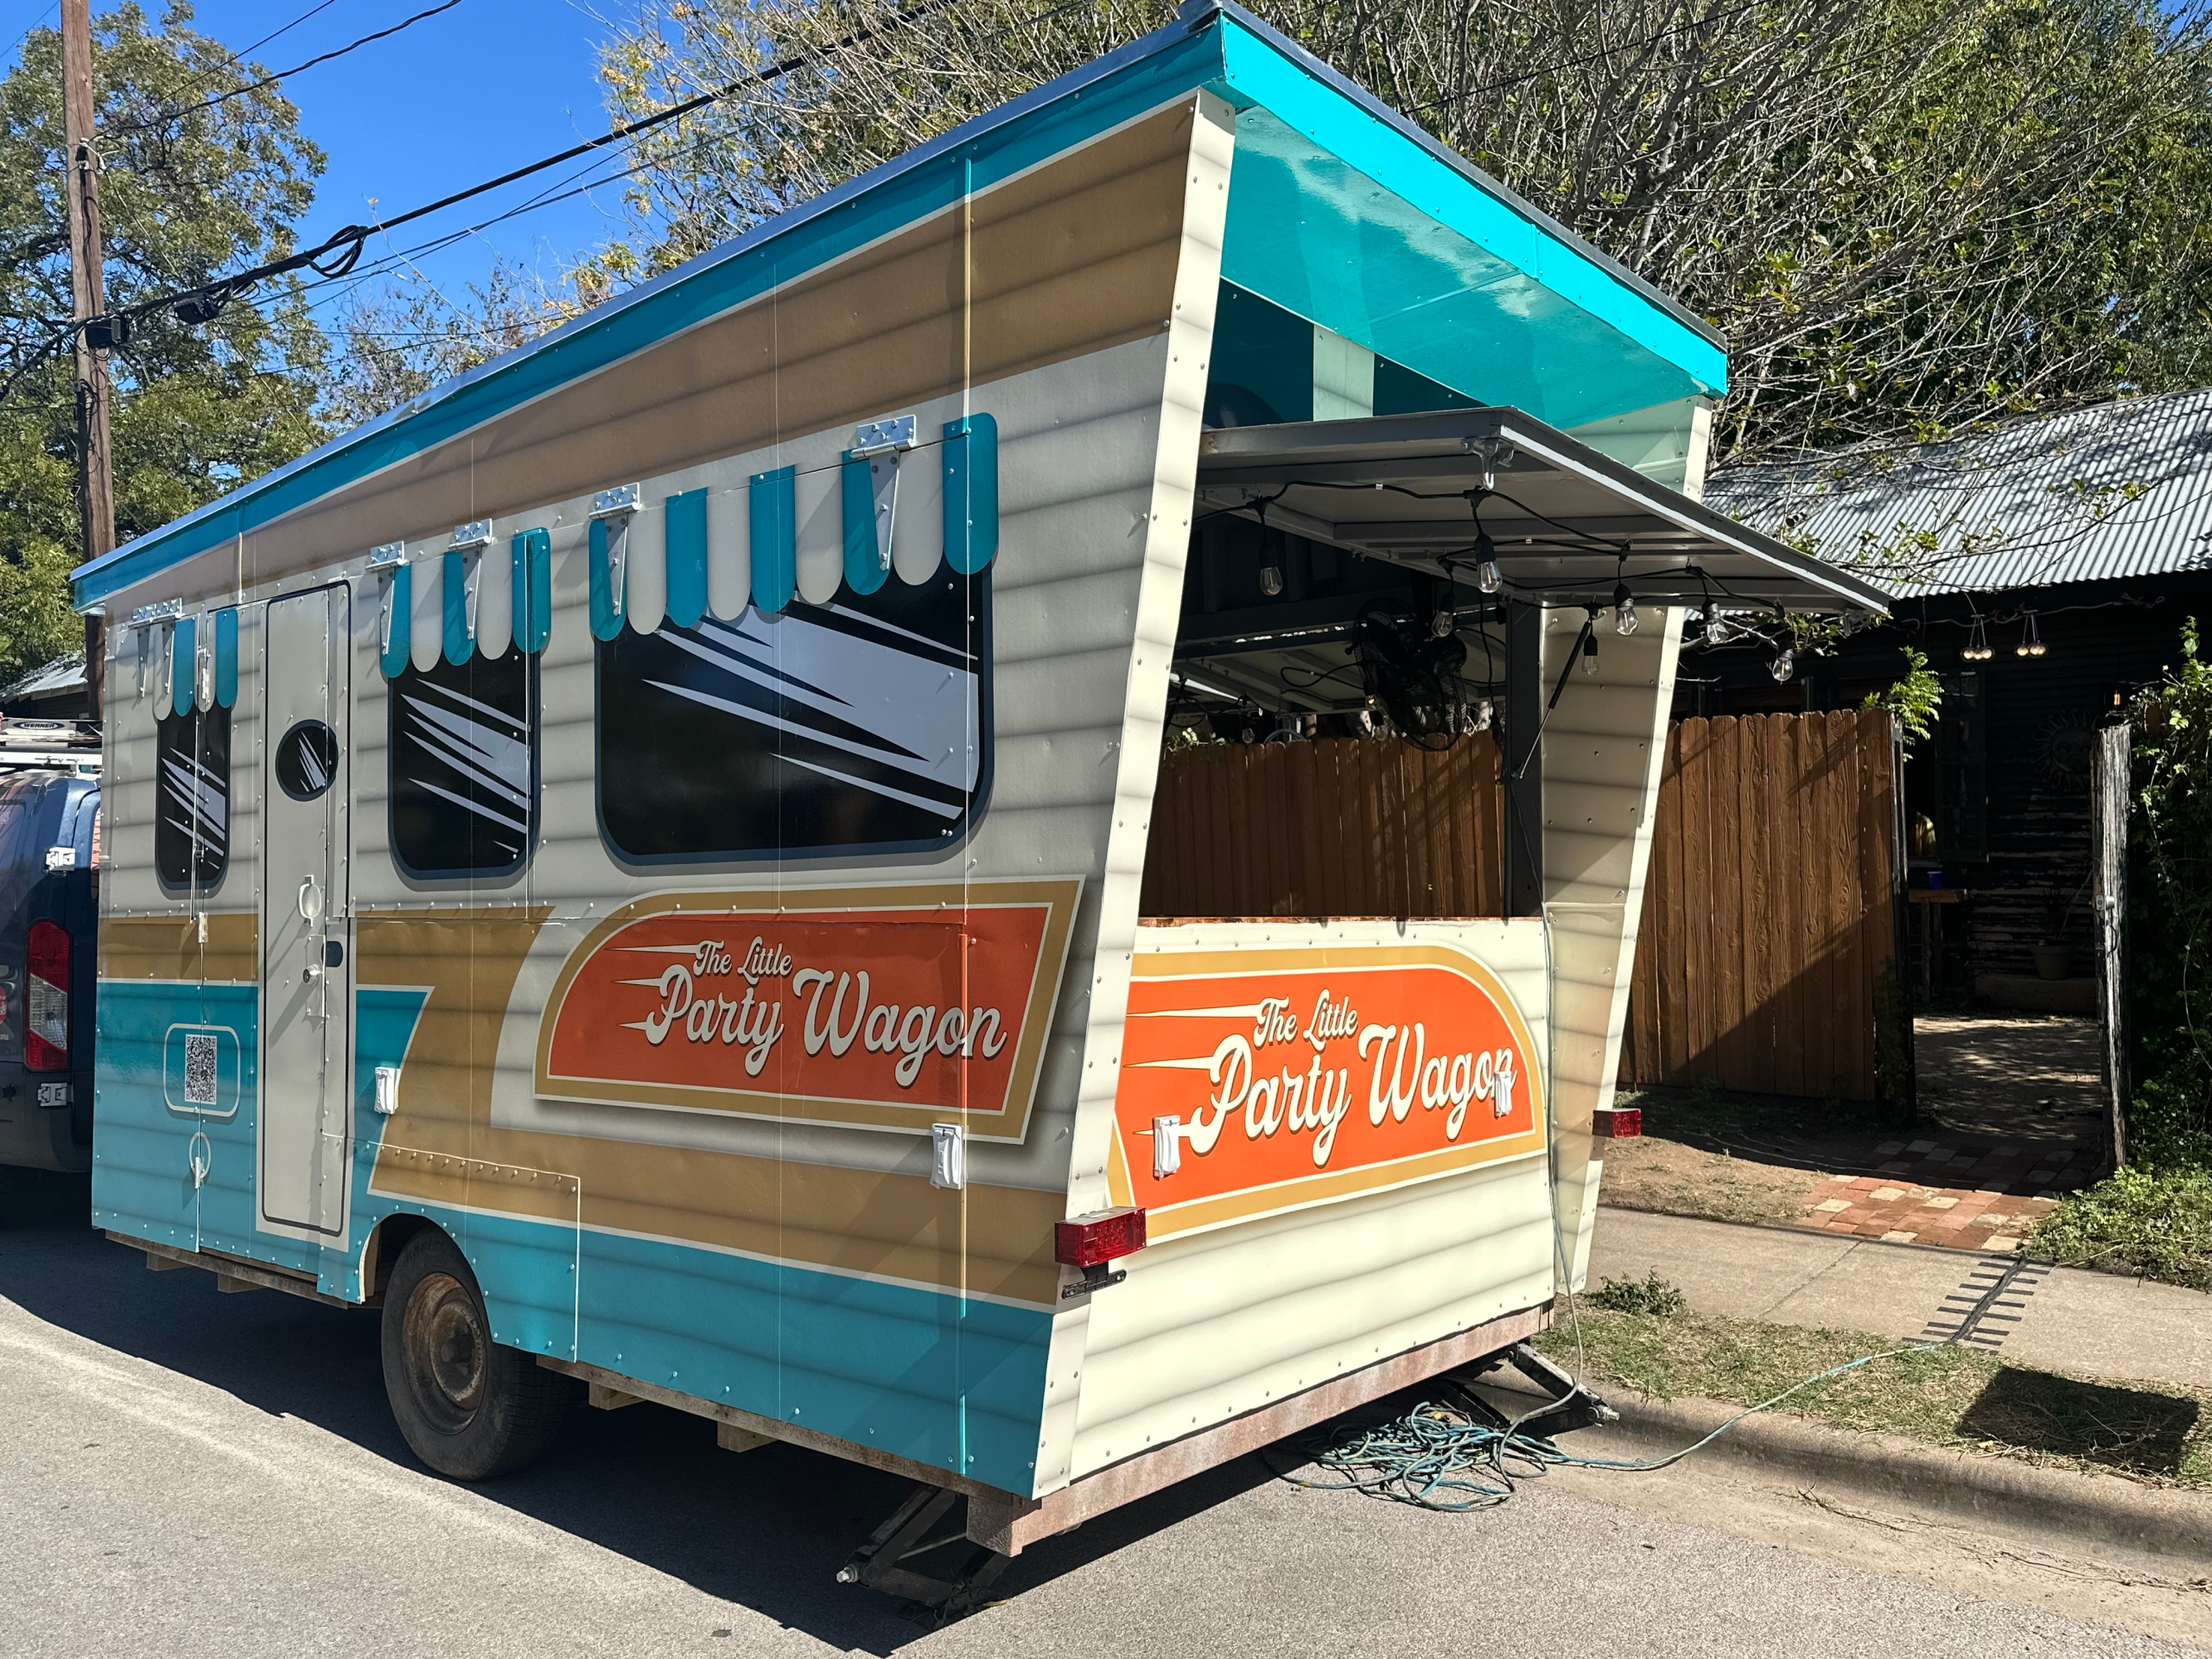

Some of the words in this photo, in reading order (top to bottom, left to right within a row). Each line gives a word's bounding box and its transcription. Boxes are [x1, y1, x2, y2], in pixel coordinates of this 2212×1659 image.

[693, 939, 733, 976] The
[737, 936, 792, 985] Little
[645, 963, 785, 1077] Party
[792, 969, 1007, 1087] Wagon
[1254, 995, 1298, 1049] The
[1303, 988, 1358, 1053] Little
[1189, 1034, 1351, 1166] Party
